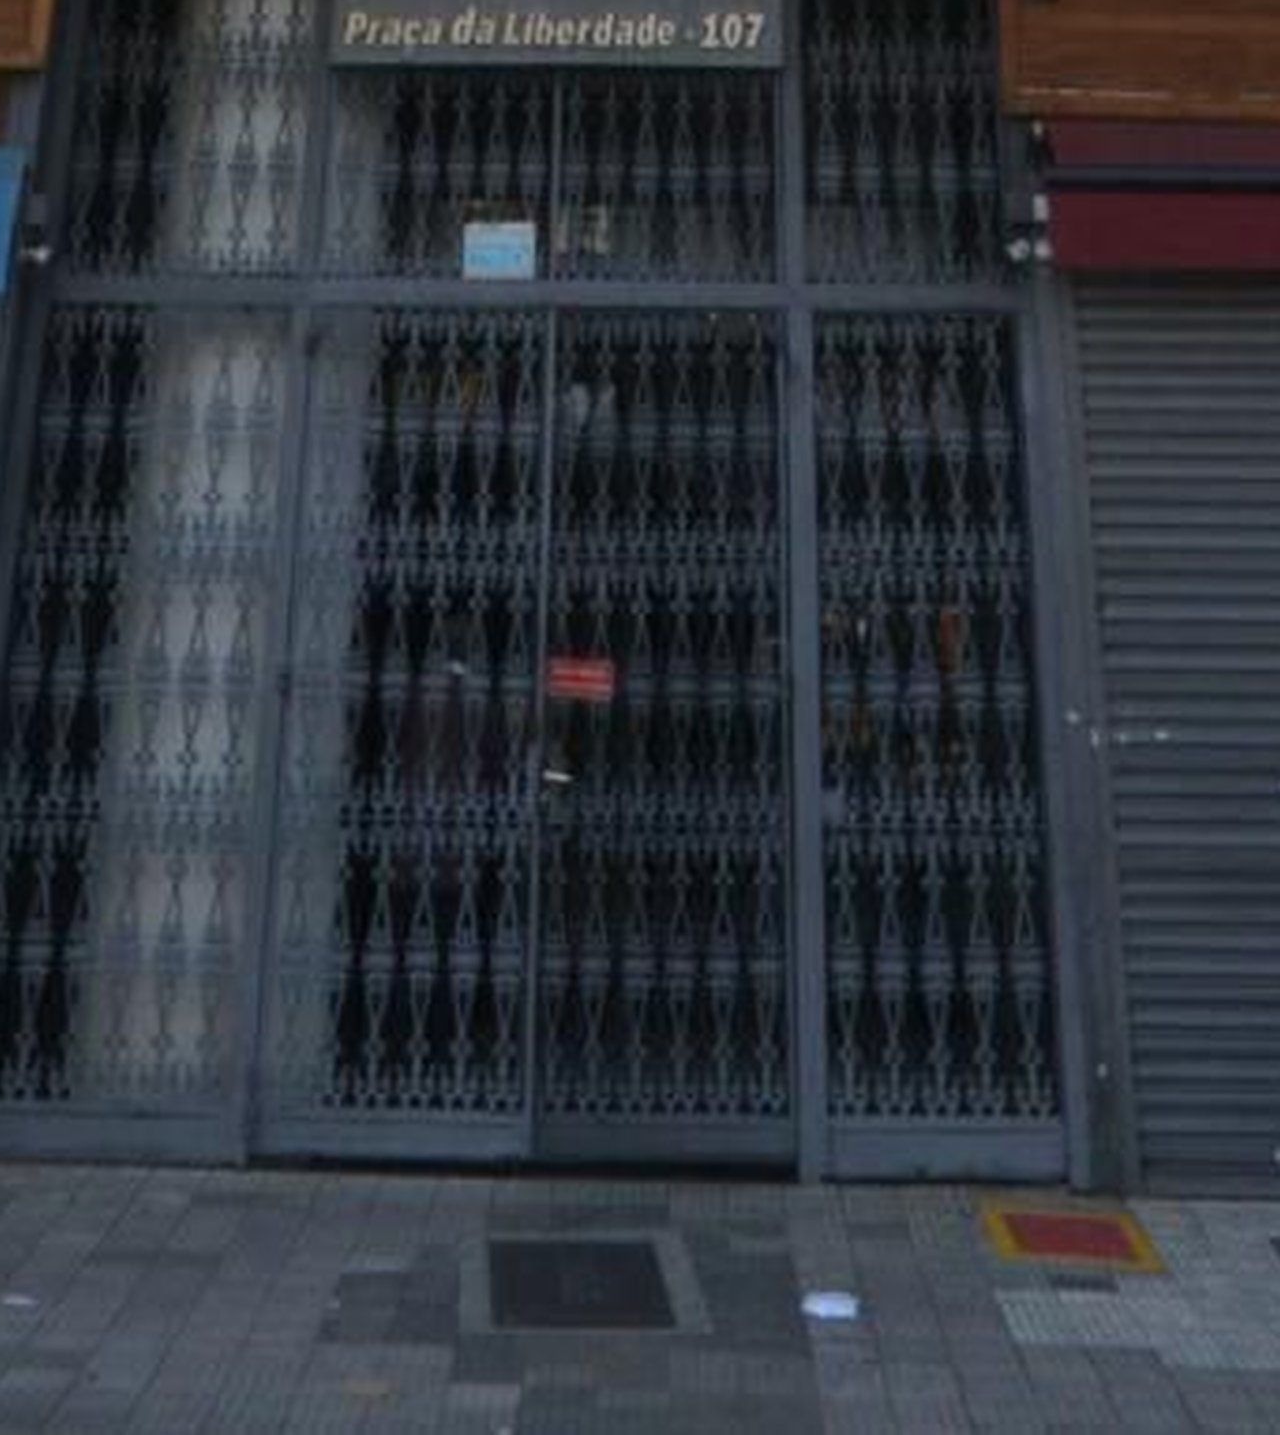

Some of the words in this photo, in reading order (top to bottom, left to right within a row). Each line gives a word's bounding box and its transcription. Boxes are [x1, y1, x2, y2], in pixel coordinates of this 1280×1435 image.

[450, 3, 496, 45] da
[502, 11, 676, 46] Liberdade
[699, 12, 765, 48] 107
